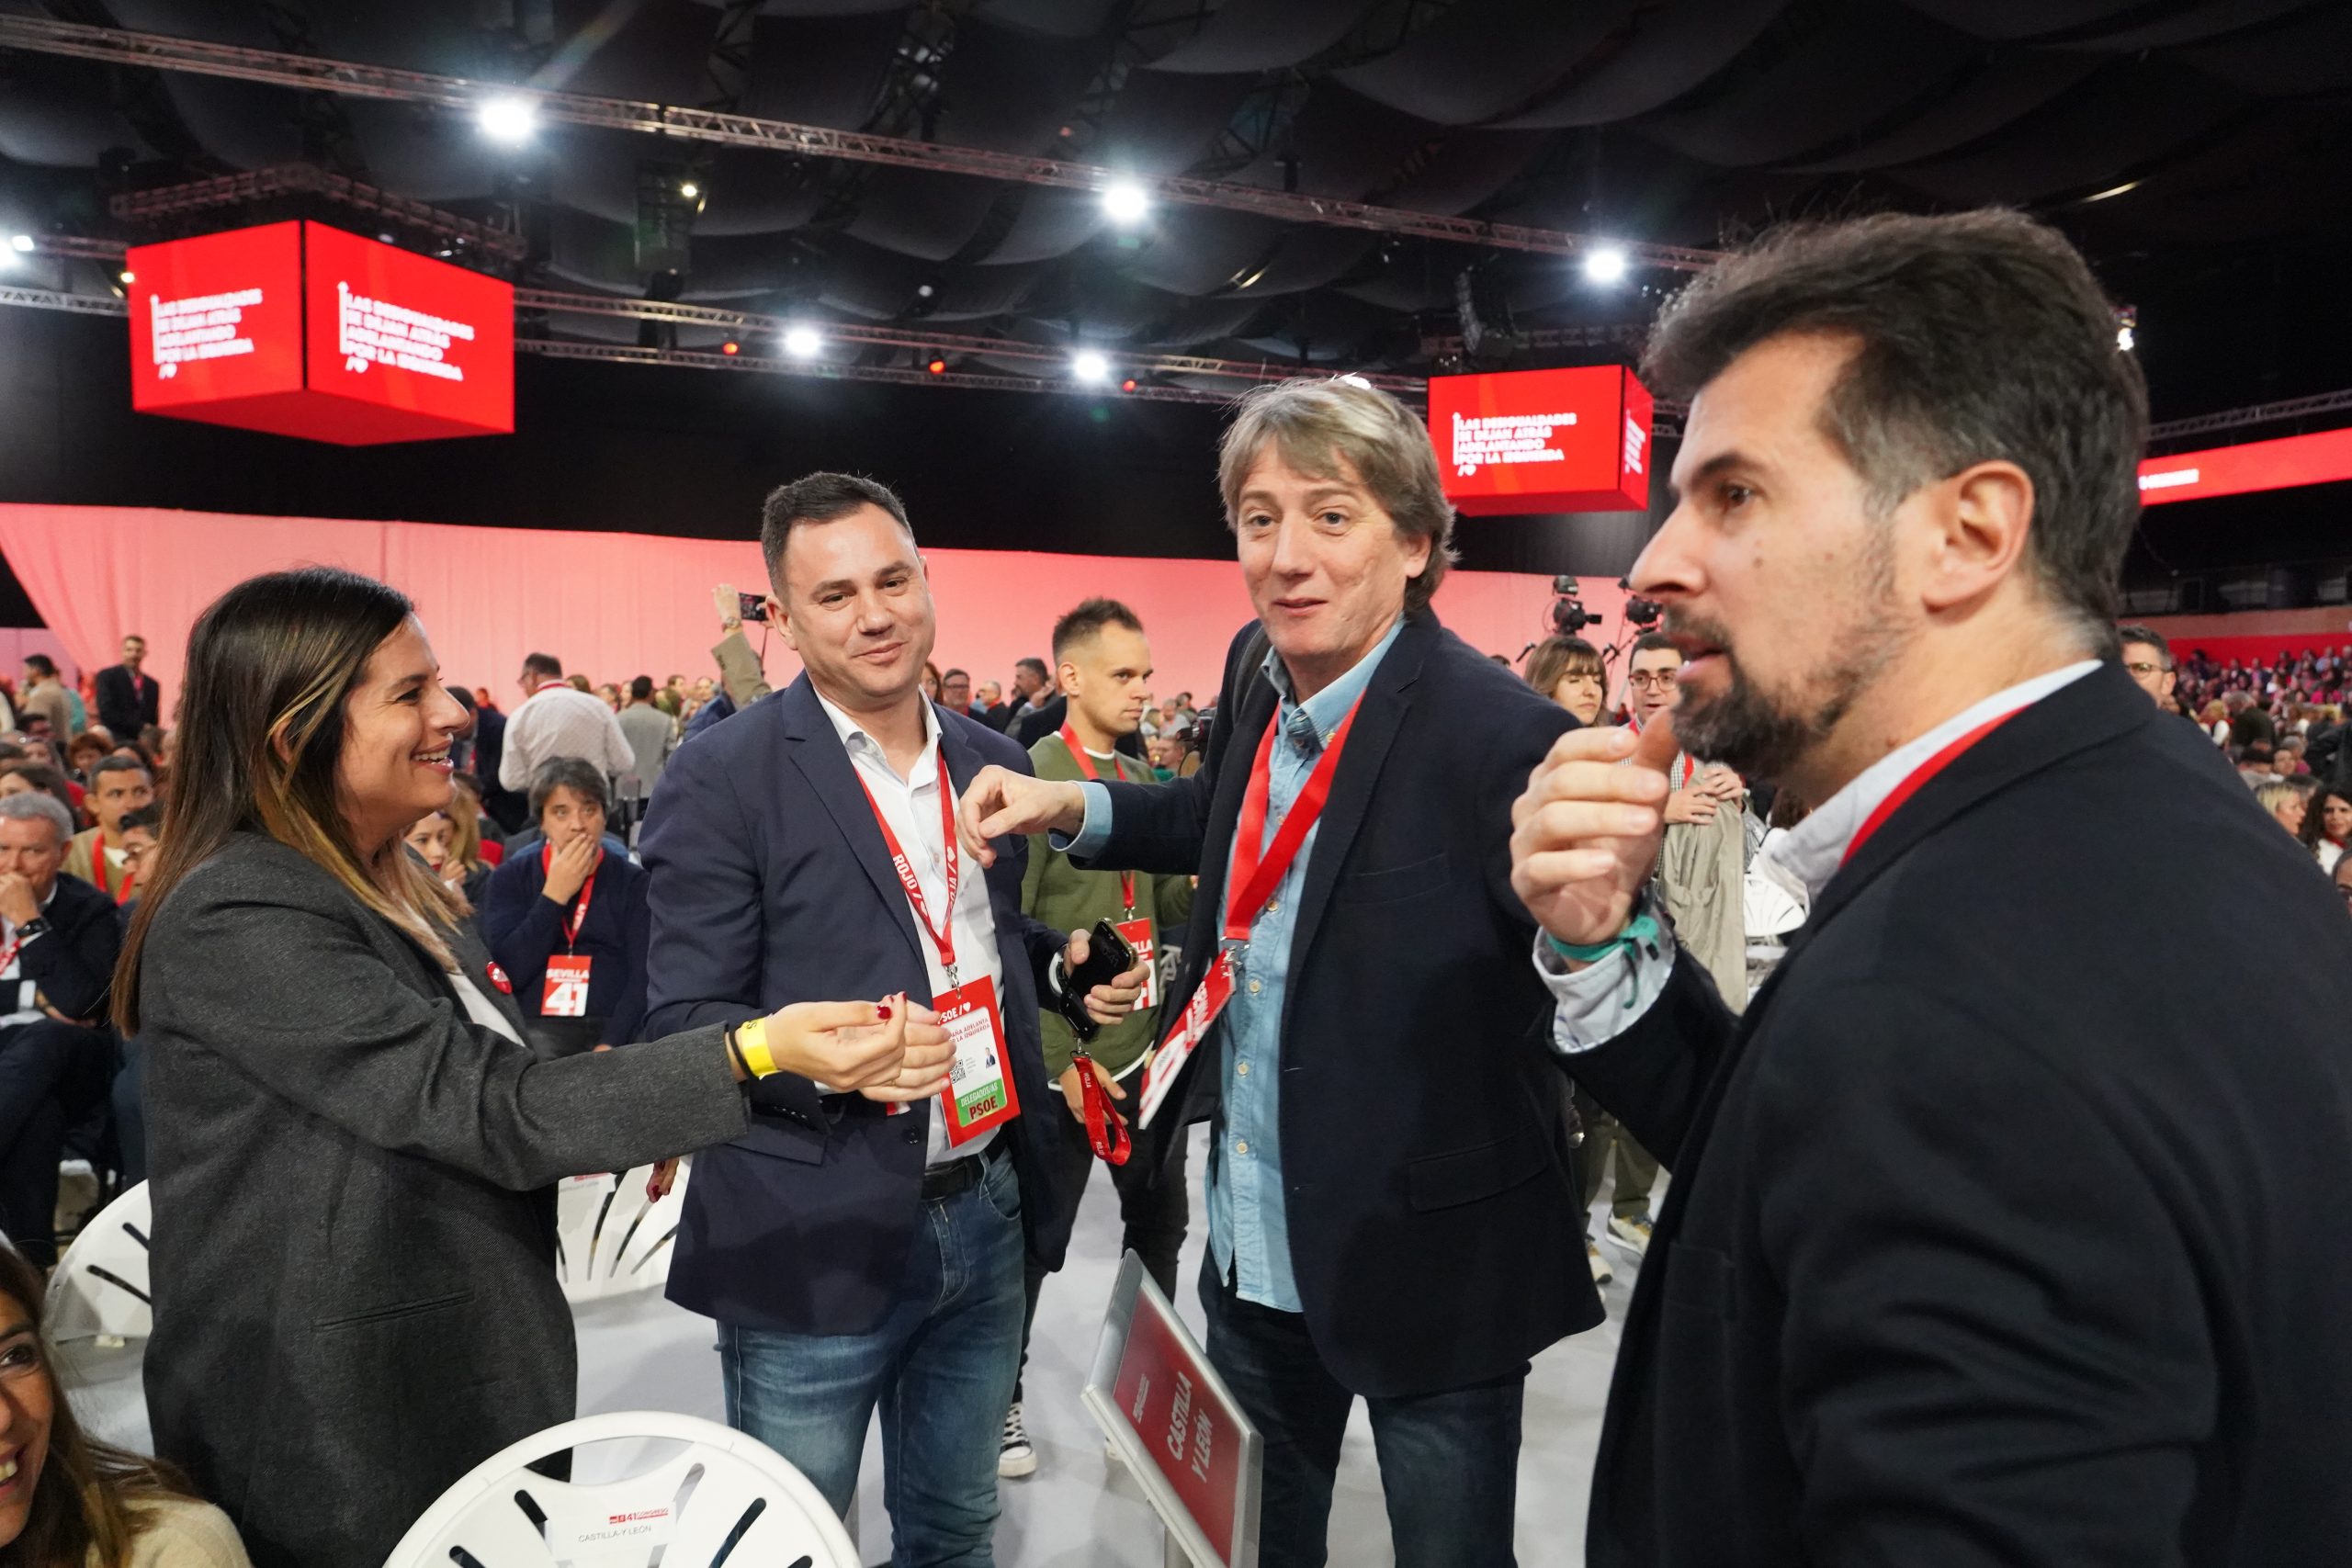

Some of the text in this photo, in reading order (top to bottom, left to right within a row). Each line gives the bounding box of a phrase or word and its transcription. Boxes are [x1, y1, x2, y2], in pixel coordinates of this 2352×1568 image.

[347, 292, 372, 313] LAS
[378, 348, 396, 366] LA
[1459, 418, 1481, 431] LAS
[1459, 452, 1484, 465] POR
[1485, 452, 1501, 464] LA
[893, 853, 917, 890] ROJO
[545, 982, 589, 1016] 41
[938, 1008, 958, 1024] SOE
[964, 1018, 989, 1032] ADELANTA
[965, 1023, 989, 1039] IZQUIERDA
[969, 1095, 998, 1120] PSOE
[1167, 1371, 1192, 1461] CASTILLA
[1192, 1408, 1213, 1483] Y LEÓN
